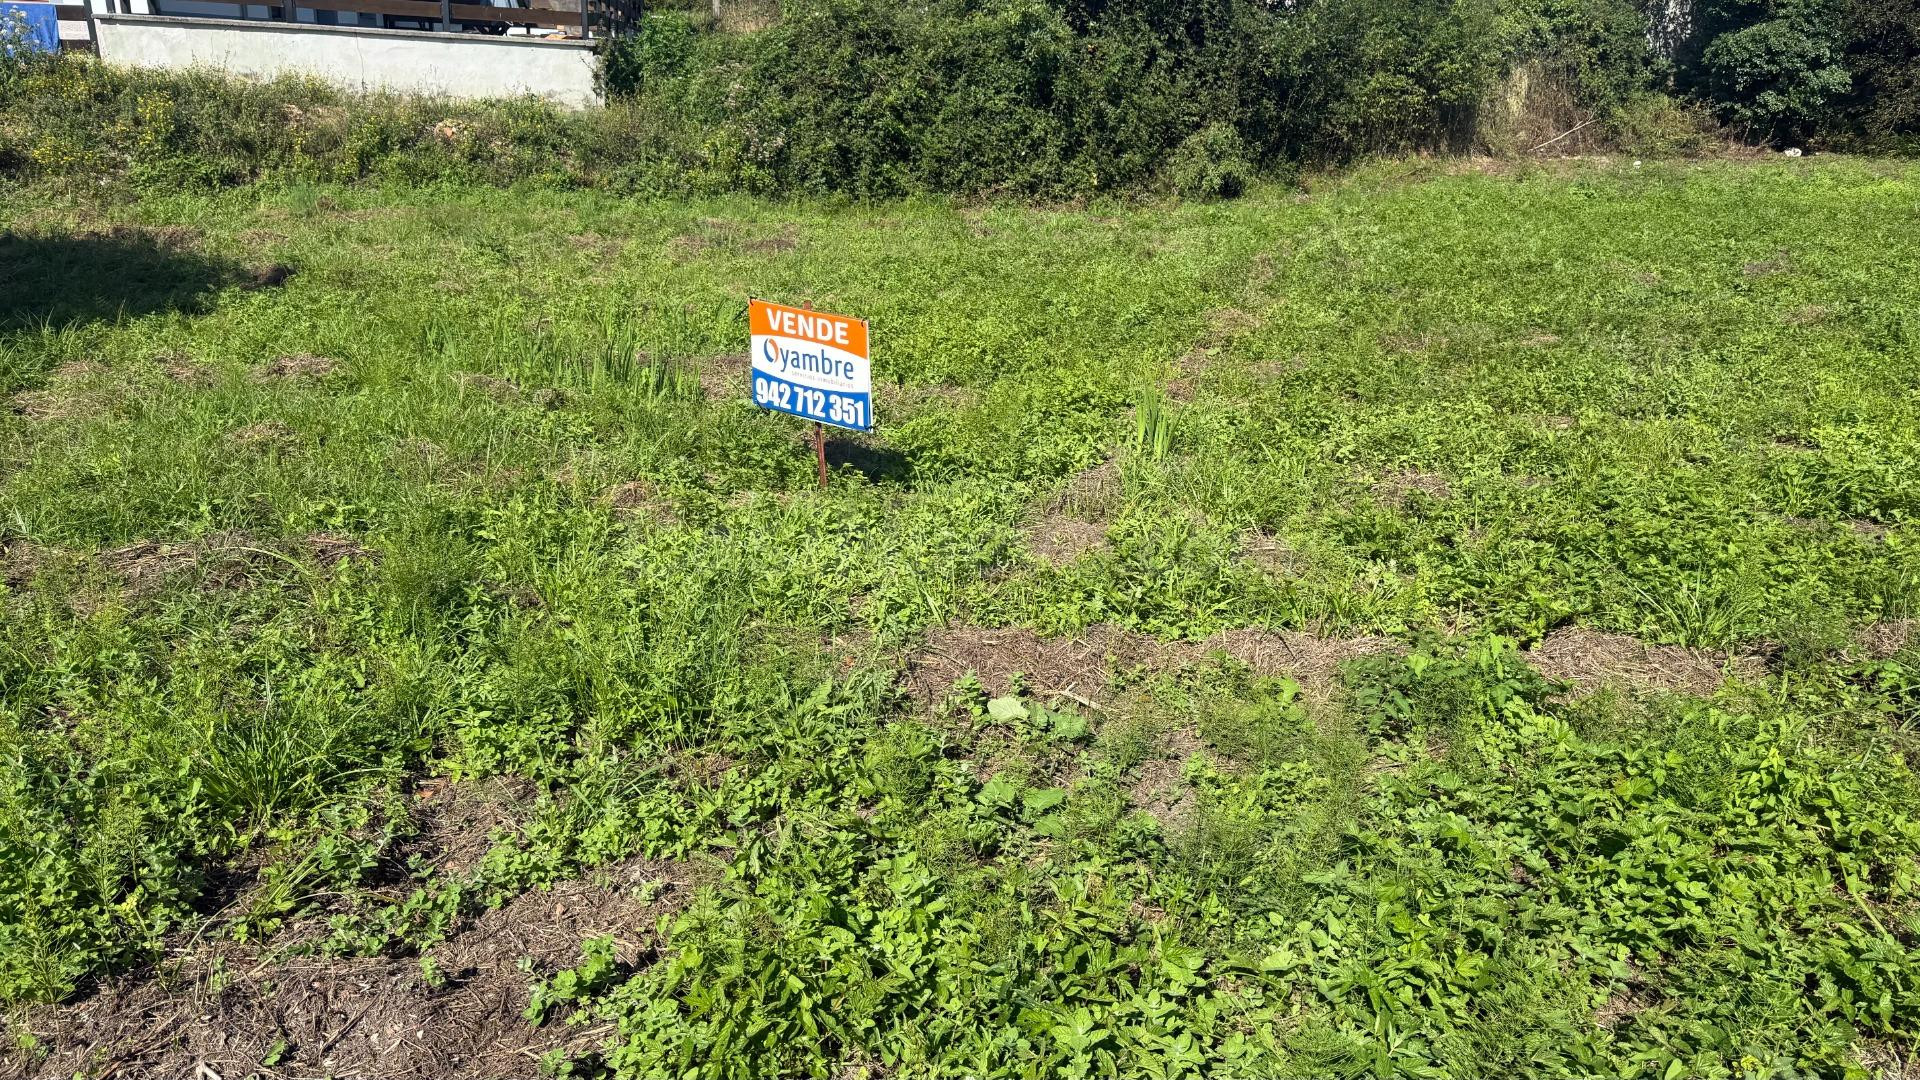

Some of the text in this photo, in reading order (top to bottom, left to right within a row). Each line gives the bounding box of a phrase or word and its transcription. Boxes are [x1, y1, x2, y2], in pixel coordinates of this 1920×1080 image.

[767, 308, 849, 345] VENDE
[763, 338, 854, 380] Oyambre
[755, 377, 865, 427] 942 712 351
